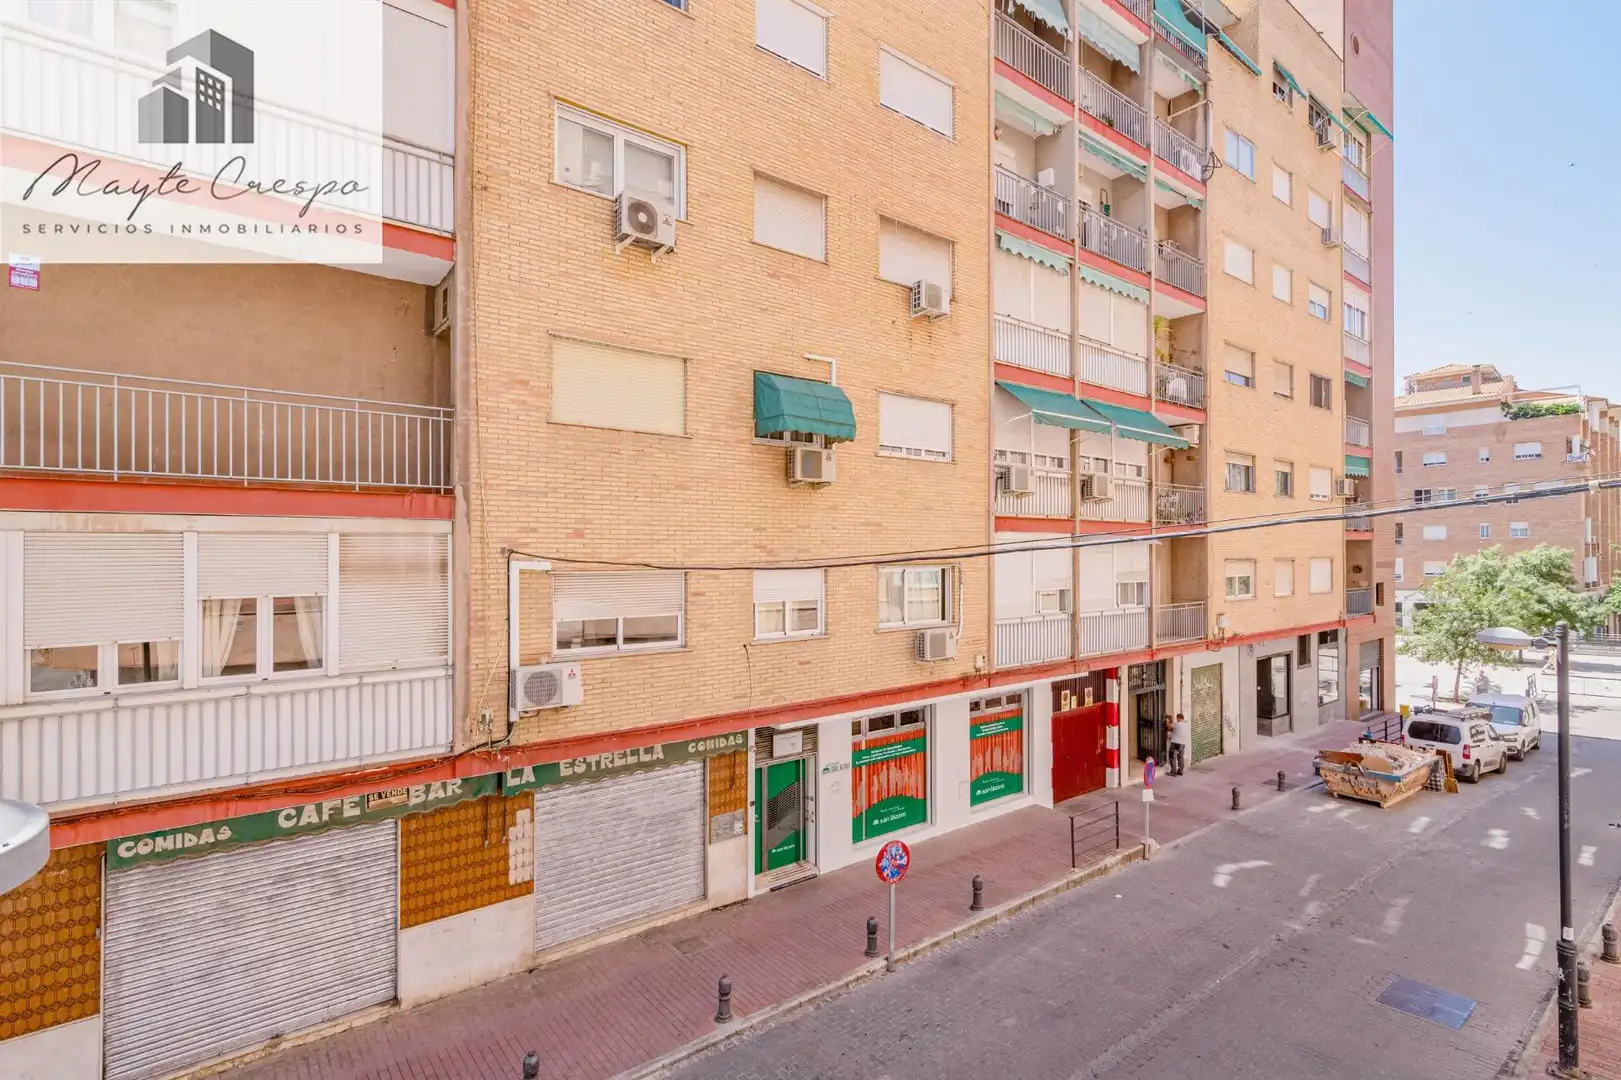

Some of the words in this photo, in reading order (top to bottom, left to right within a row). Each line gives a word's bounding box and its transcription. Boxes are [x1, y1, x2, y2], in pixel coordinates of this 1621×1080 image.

[688, 735, 743, 753] COMIDAS
[506, 765, 536, 788] LA
[560, 744, 664, 776] ESTRELLA
[278, 797, 361, 828] CAFE
[409, 780, 462, 806] BAR
[367, 790, 379, 802] SE
[381, 787, 408, 800] VENDE
[117, 827, 231, 858] COMIDAS
